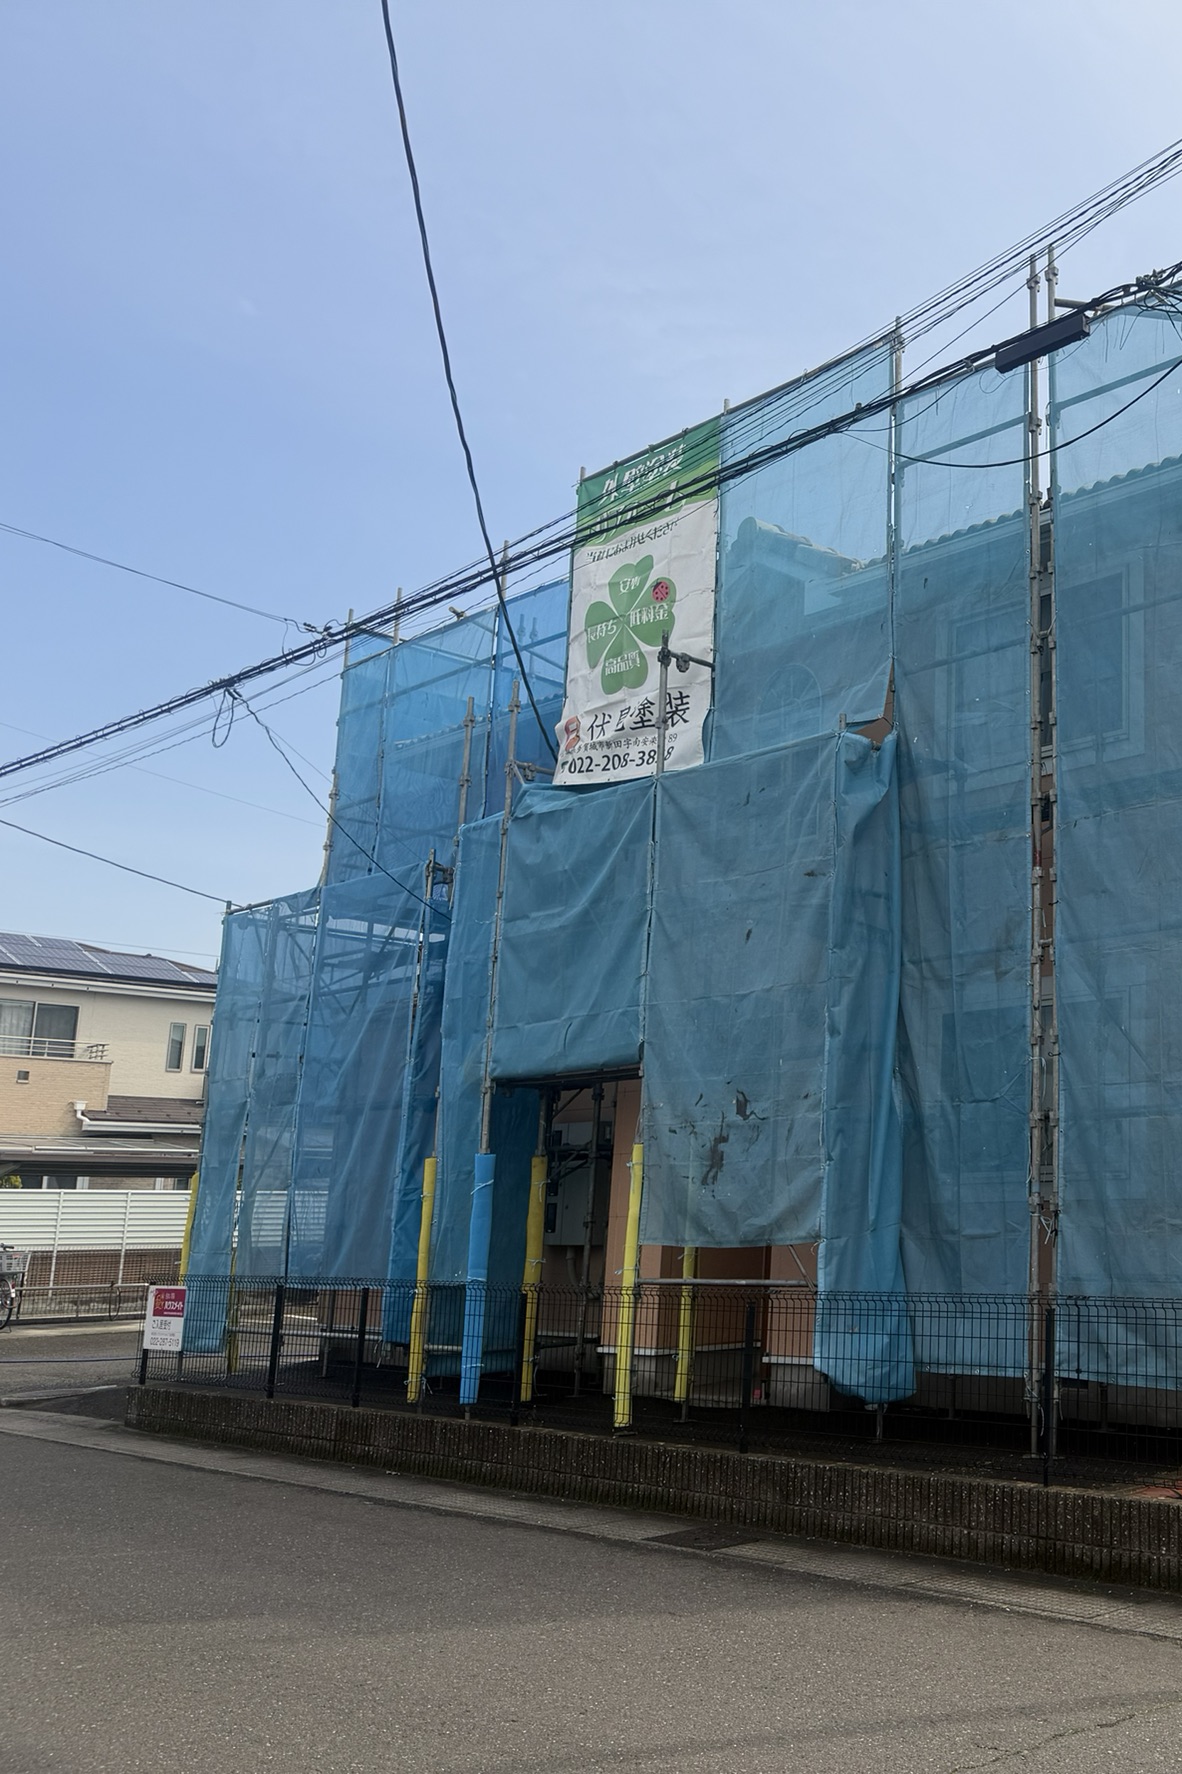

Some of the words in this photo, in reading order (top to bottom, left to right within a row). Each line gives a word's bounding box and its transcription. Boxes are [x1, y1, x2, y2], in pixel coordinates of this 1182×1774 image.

[629, 603, 669, 628] 低料金
[605, 650, 641, 676] 高品質
[568, 746, 674, 774] 022-208-388
